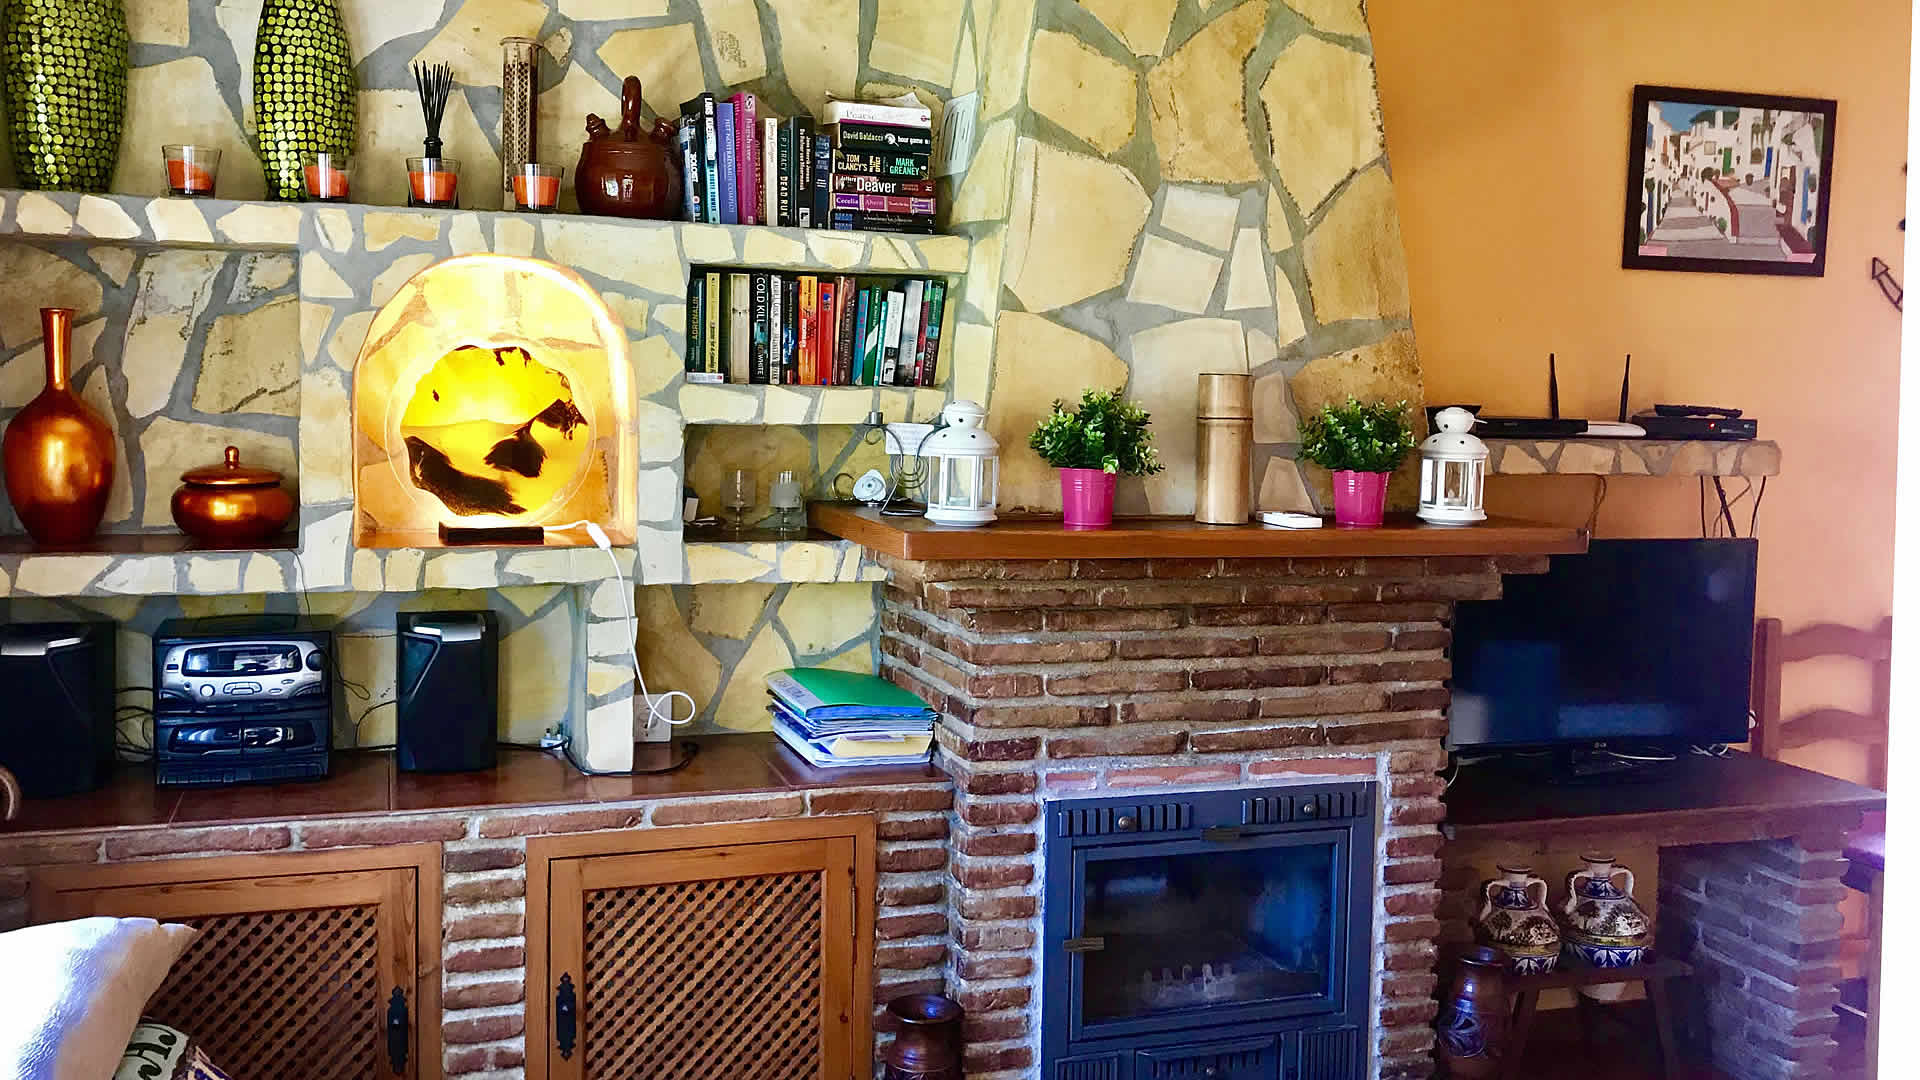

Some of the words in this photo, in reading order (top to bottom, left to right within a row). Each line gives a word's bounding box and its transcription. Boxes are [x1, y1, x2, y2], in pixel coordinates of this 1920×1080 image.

[705, 98, 713, 115] LARS
[842, 130, 859, 140] David
[859, 132, 884, 141] Baldacci
[780, 149, 788, 171] TRACY
[837, 161, 868, 172] CLANCY'S
[846, 154, 860, 163] TOM
[895, 158, 914, 167] MARK
[889, 165, 920, 176] GREANEY
[780, 175, 788, 198] DEAD
[856, 177, 896, 193] Deaver
[780, 199, 788, 217] RUN
[836, 197, 859, 205] Cecelia
[756, 277, 765, 303] COLD
[756, 304, 766, 324] KILL
